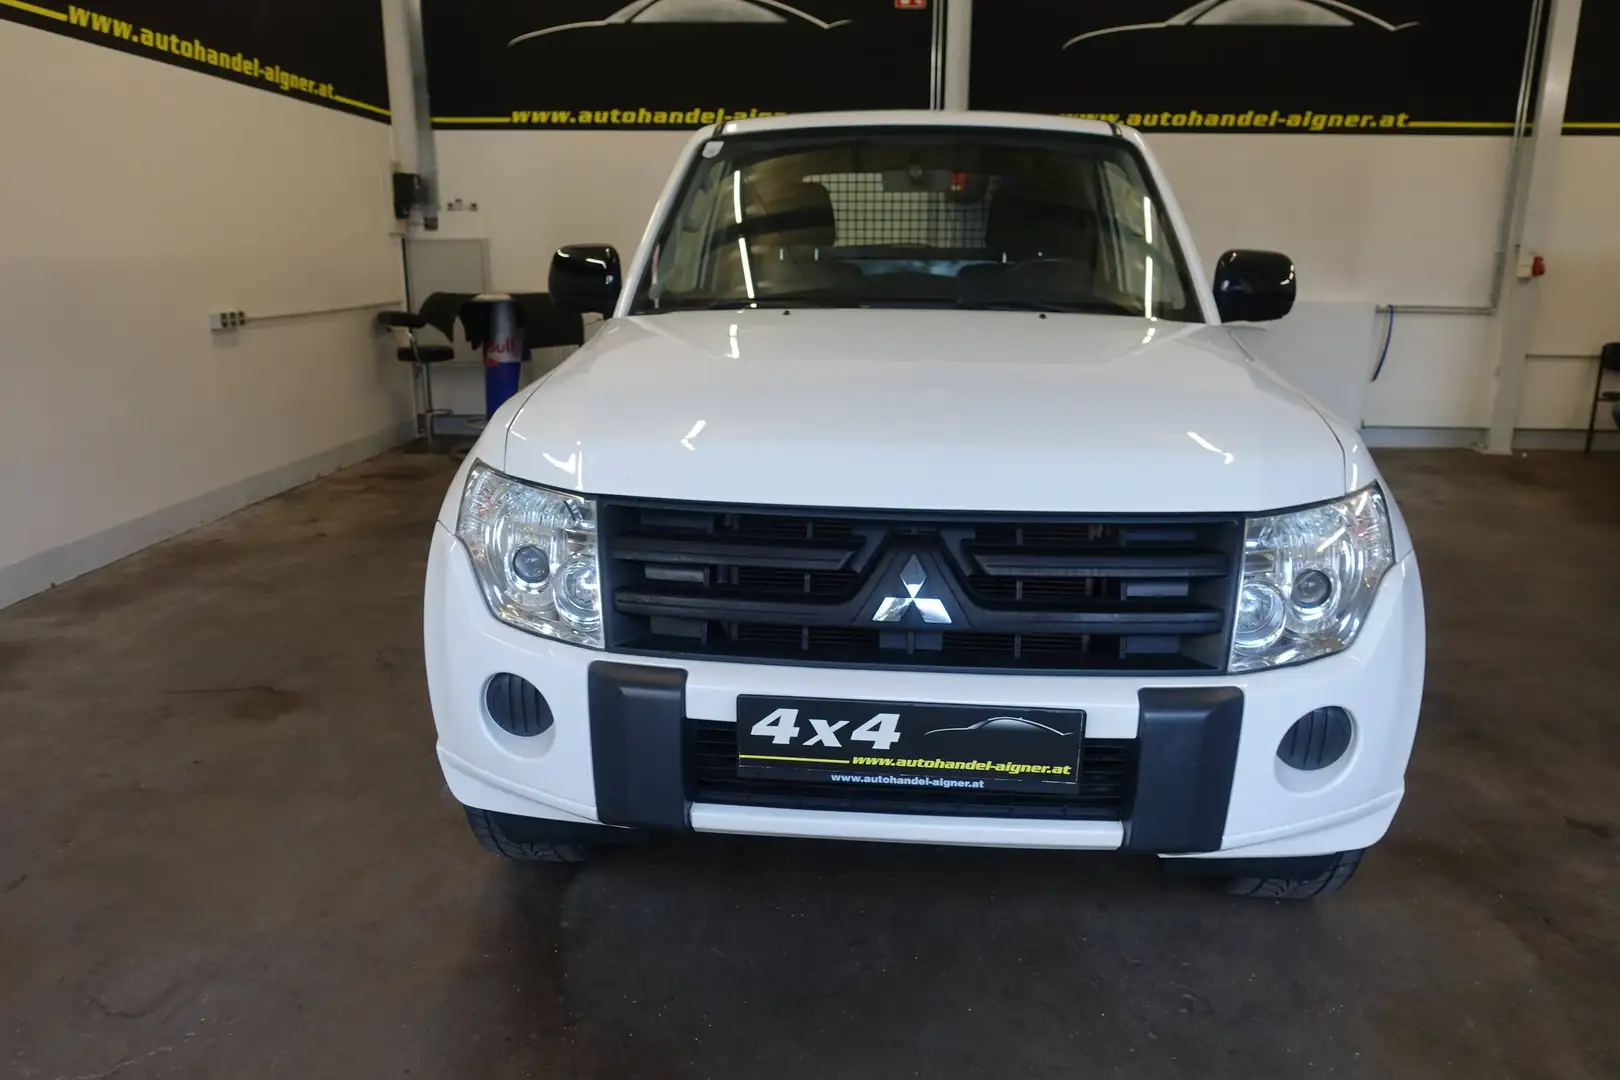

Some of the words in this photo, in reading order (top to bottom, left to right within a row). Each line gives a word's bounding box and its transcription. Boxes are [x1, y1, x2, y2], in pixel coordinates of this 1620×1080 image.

[67, 4, 335, 100] www.autohandel-aigner.at
[750, 707, 901, 750] 4x4
[830, 773, 985, 789] www.autohandel-aigner.at
[852, 755, 1073, 776] www.autohandel-aigner.at
